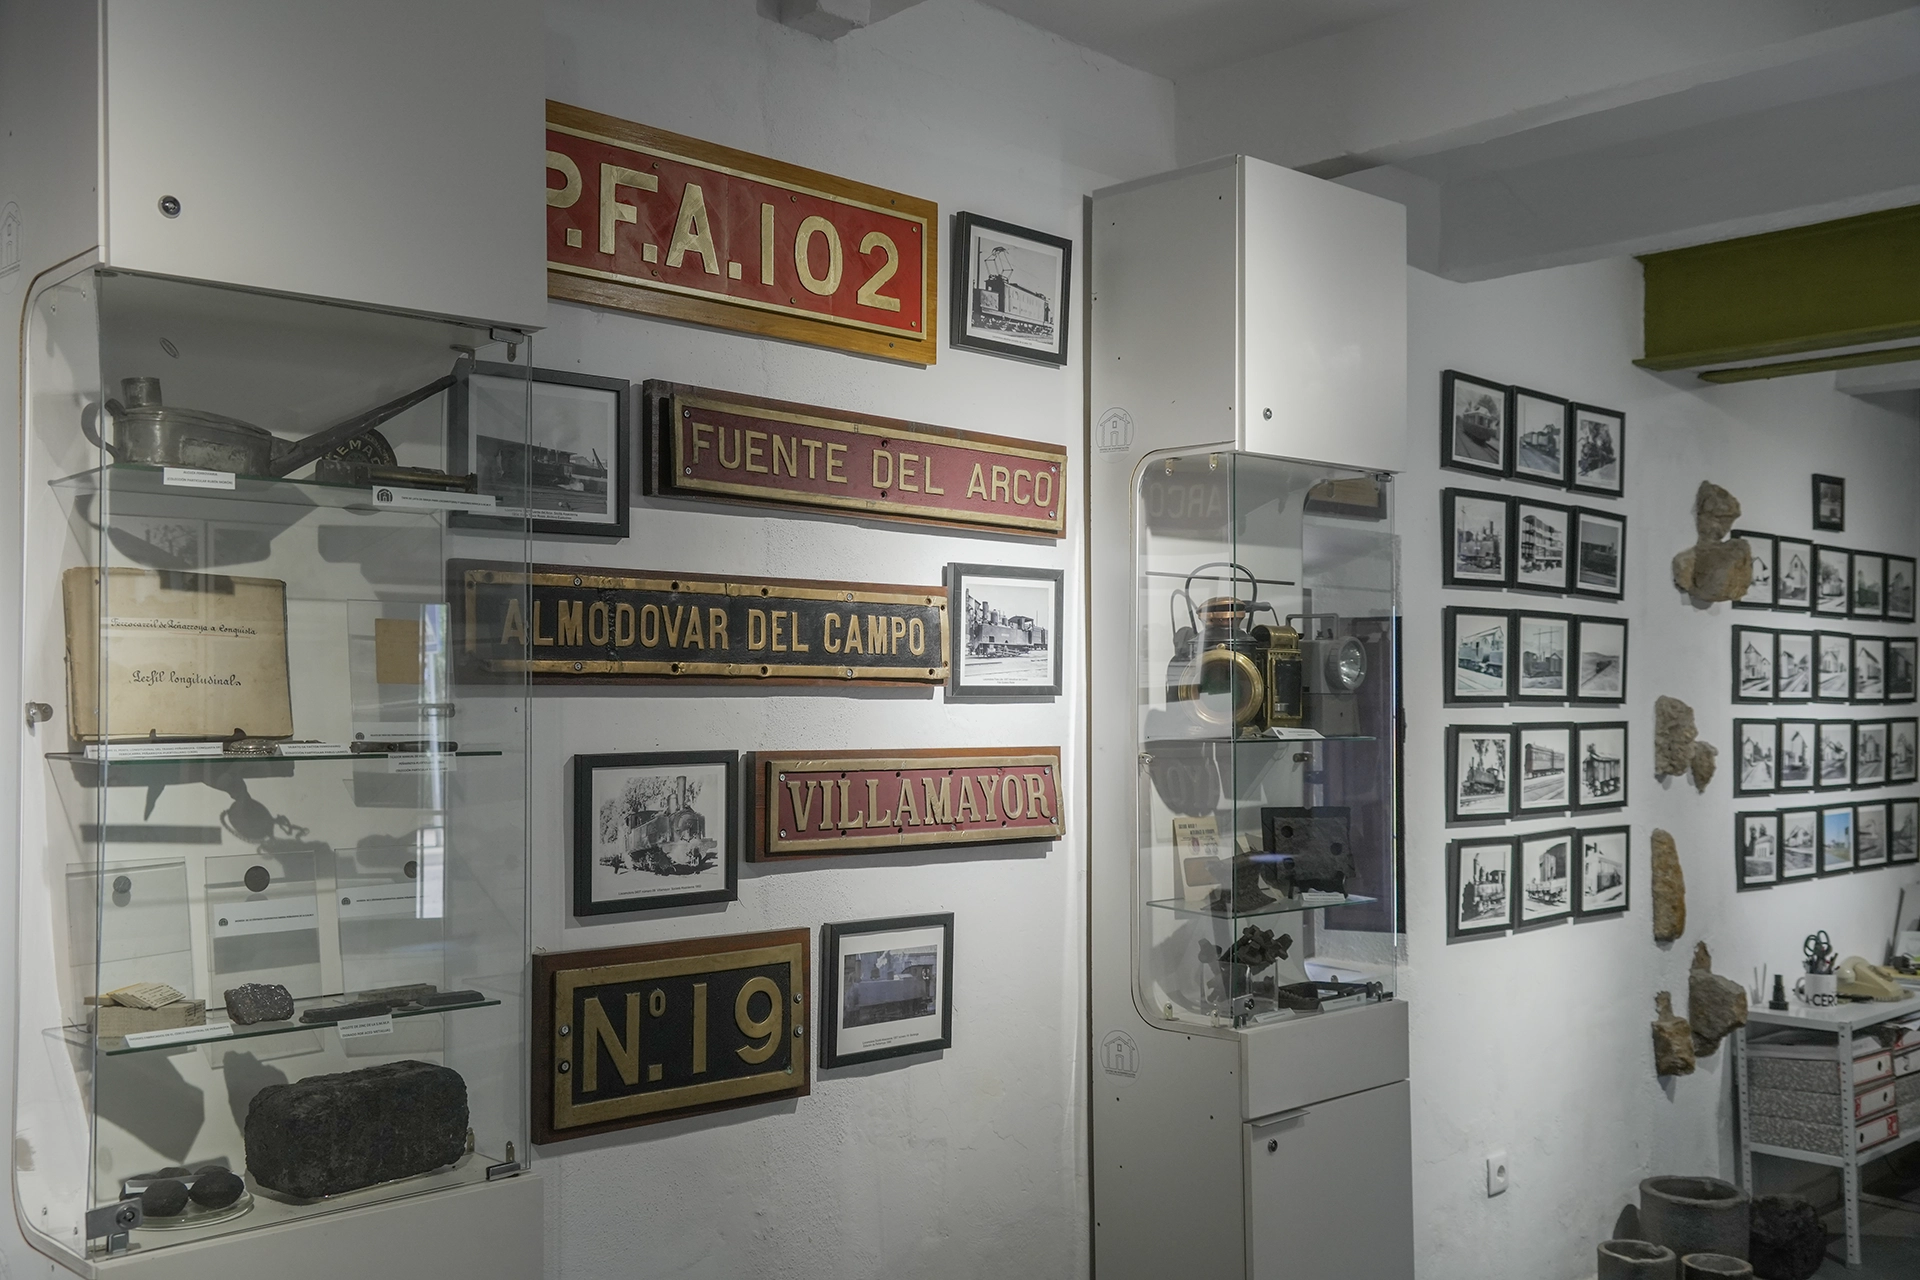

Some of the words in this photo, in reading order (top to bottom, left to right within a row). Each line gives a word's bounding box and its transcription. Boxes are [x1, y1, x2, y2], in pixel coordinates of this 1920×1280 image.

[691, 421, 848, 484] FUENTE
[872, 448, 944, 495] DEL
[966, 463, 1053, 507] ARCO
[500, 599, 729, 650] ALMODOVAR
[747, 609, 809, 653] DEL
[823, 612, 925, 656] CAMPO
[786, 772, 1050, 832] VILLAMAYOR
